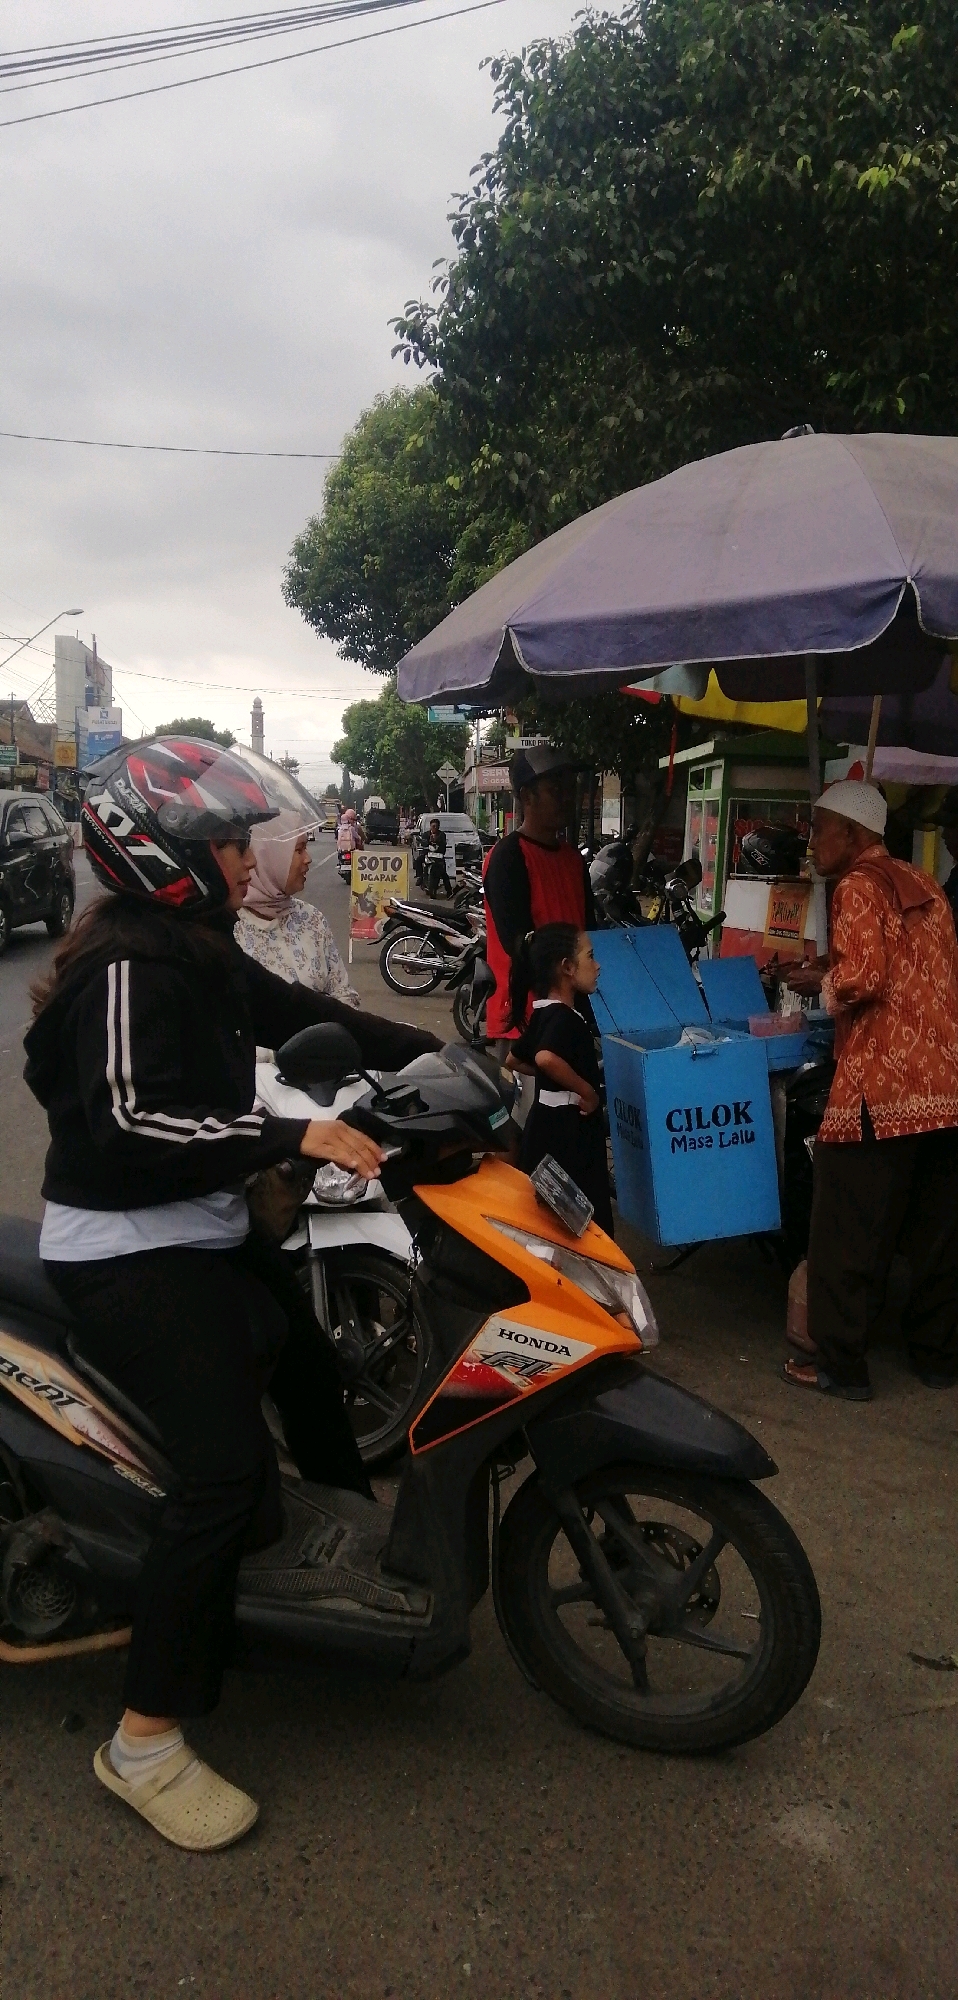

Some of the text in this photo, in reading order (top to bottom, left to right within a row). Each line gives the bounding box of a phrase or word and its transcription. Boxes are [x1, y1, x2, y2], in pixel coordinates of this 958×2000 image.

[521, 739, 536, 747] TOKO
[357, 856, 403, 872] SOTO
[360, 873, 398, 882] NGAPAK
[614, 1096, 643, 1132] CILOK
[665, 1100, 755, 1133] CILOK
[670, 1129, 756, 1154] Masa Lalu
[497, 1327, 572, 1357] HONDA
[480, 1350, 553, 1377] FI
